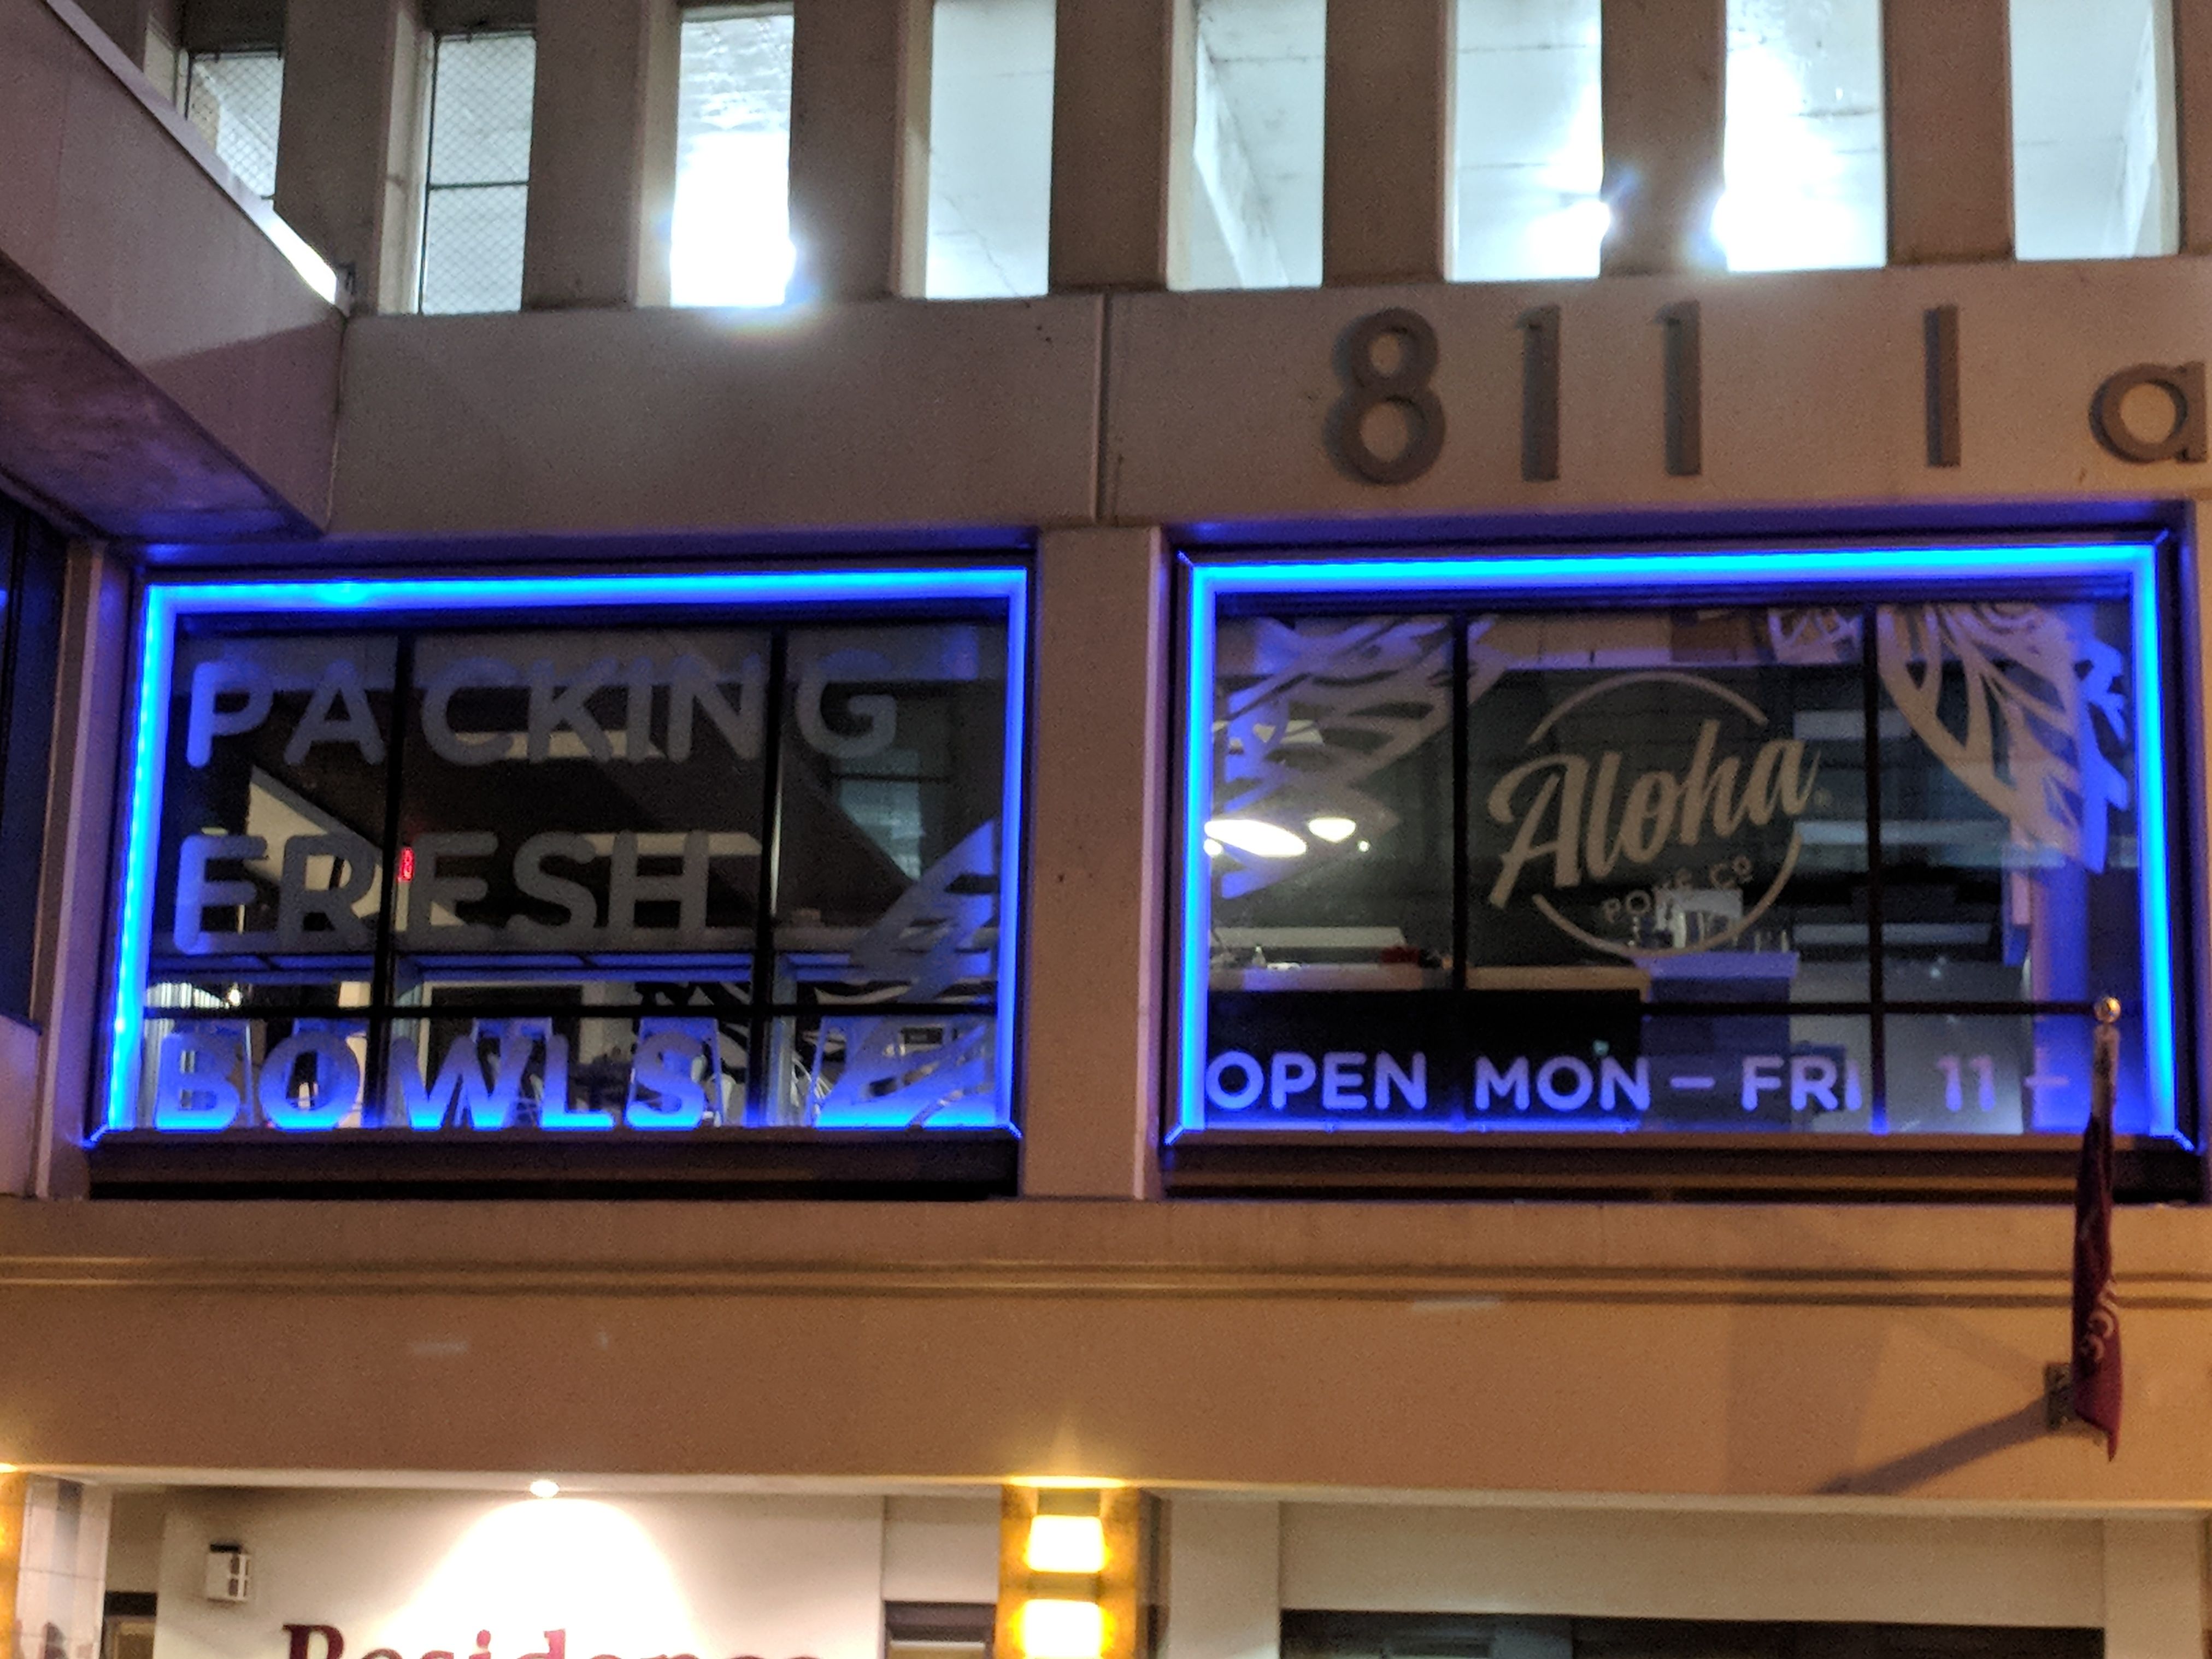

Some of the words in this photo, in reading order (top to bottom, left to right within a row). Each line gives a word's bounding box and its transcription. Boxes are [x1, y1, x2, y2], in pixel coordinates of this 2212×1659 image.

[1326, 299, 1703, 486] 811
[185, 650, 899, 769] PACKING
[1487, 719, 1822, 910] Aloha
[174, 829, 713, 955] FRESH
[153, 1032, 706, 1131] BOWLS
[1205, 1050, 1427, 1110] OPEN
[1475, 1055, 1651, 1111] MON
[1741, 1055, 1862, 1111] FRI
[1937, 1054, 1996, 1113] 11
